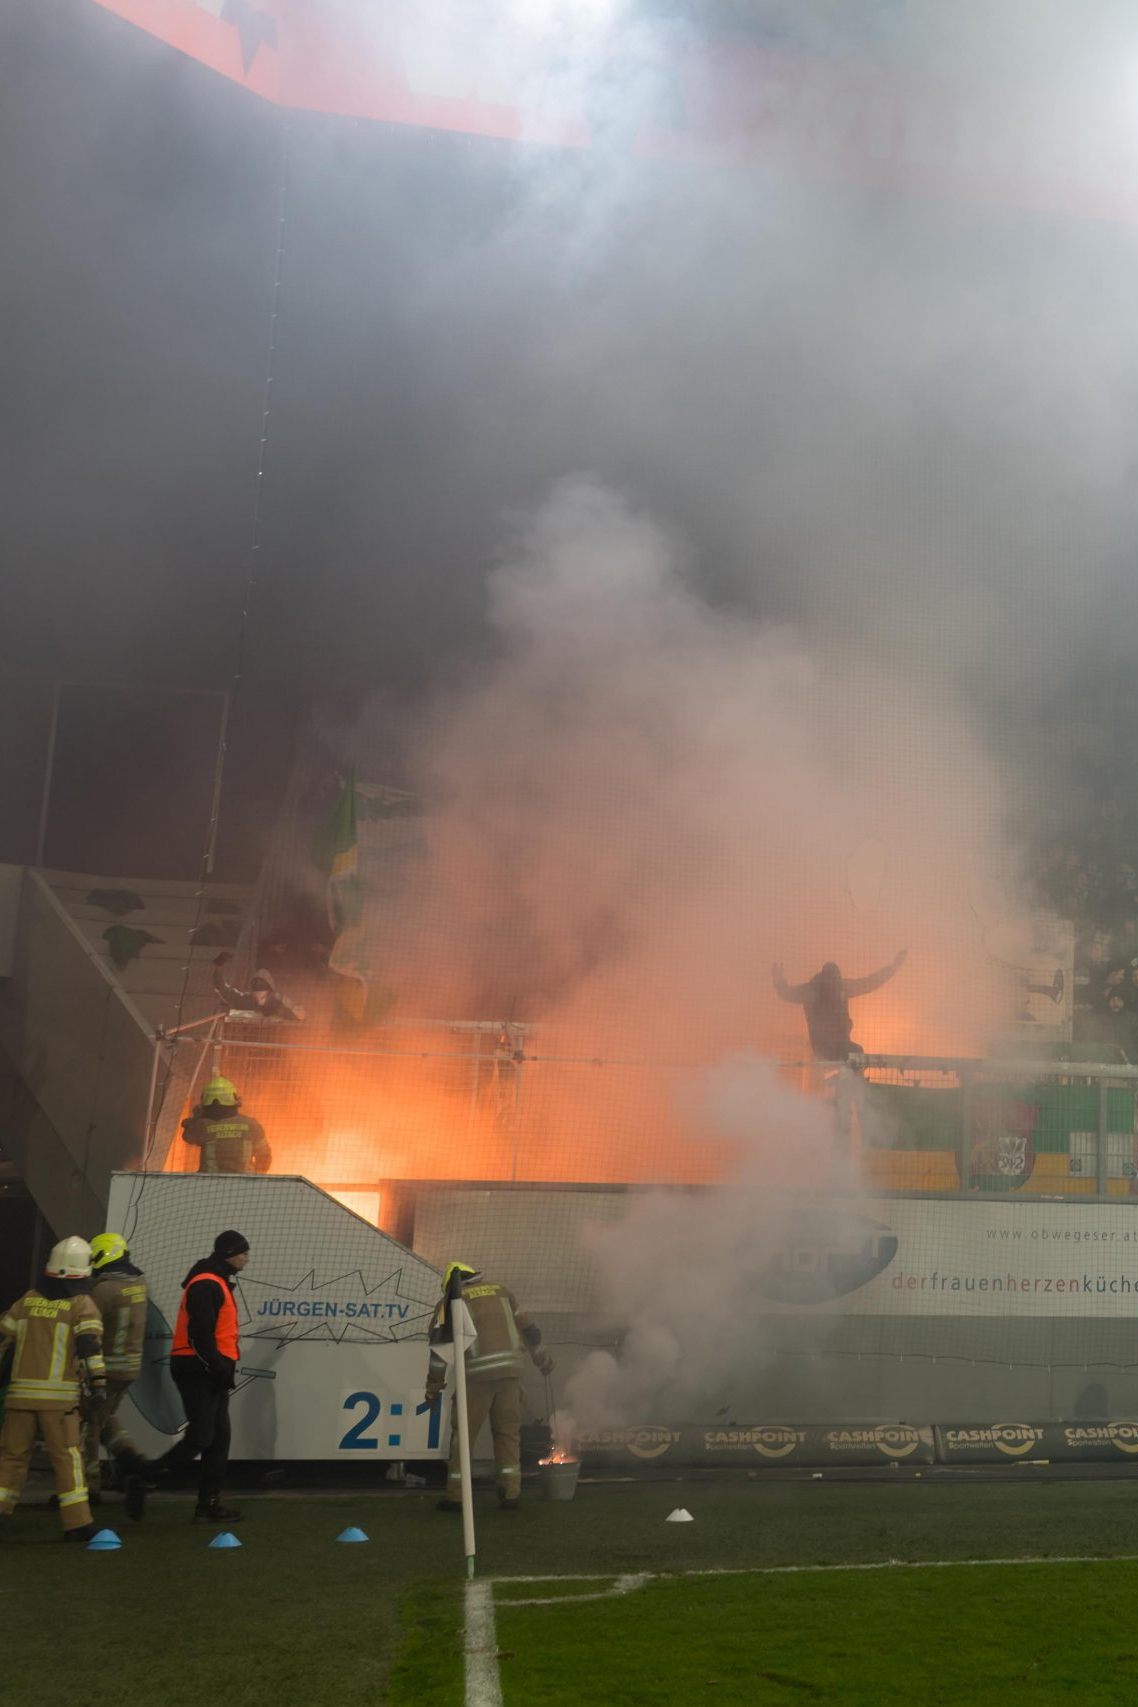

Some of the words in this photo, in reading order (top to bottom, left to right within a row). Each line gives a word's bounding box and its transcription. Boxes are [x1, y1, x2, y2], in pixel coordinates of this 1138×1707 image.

[257, 1299, 410, 1319] JÜRGEN-SAT.TV
[338, 1391, 442, 1450] 2:1
[704, 1431, 807, 1442] CASHPOINT
[946, 1428, 1044, 1441] CASHPOINT
